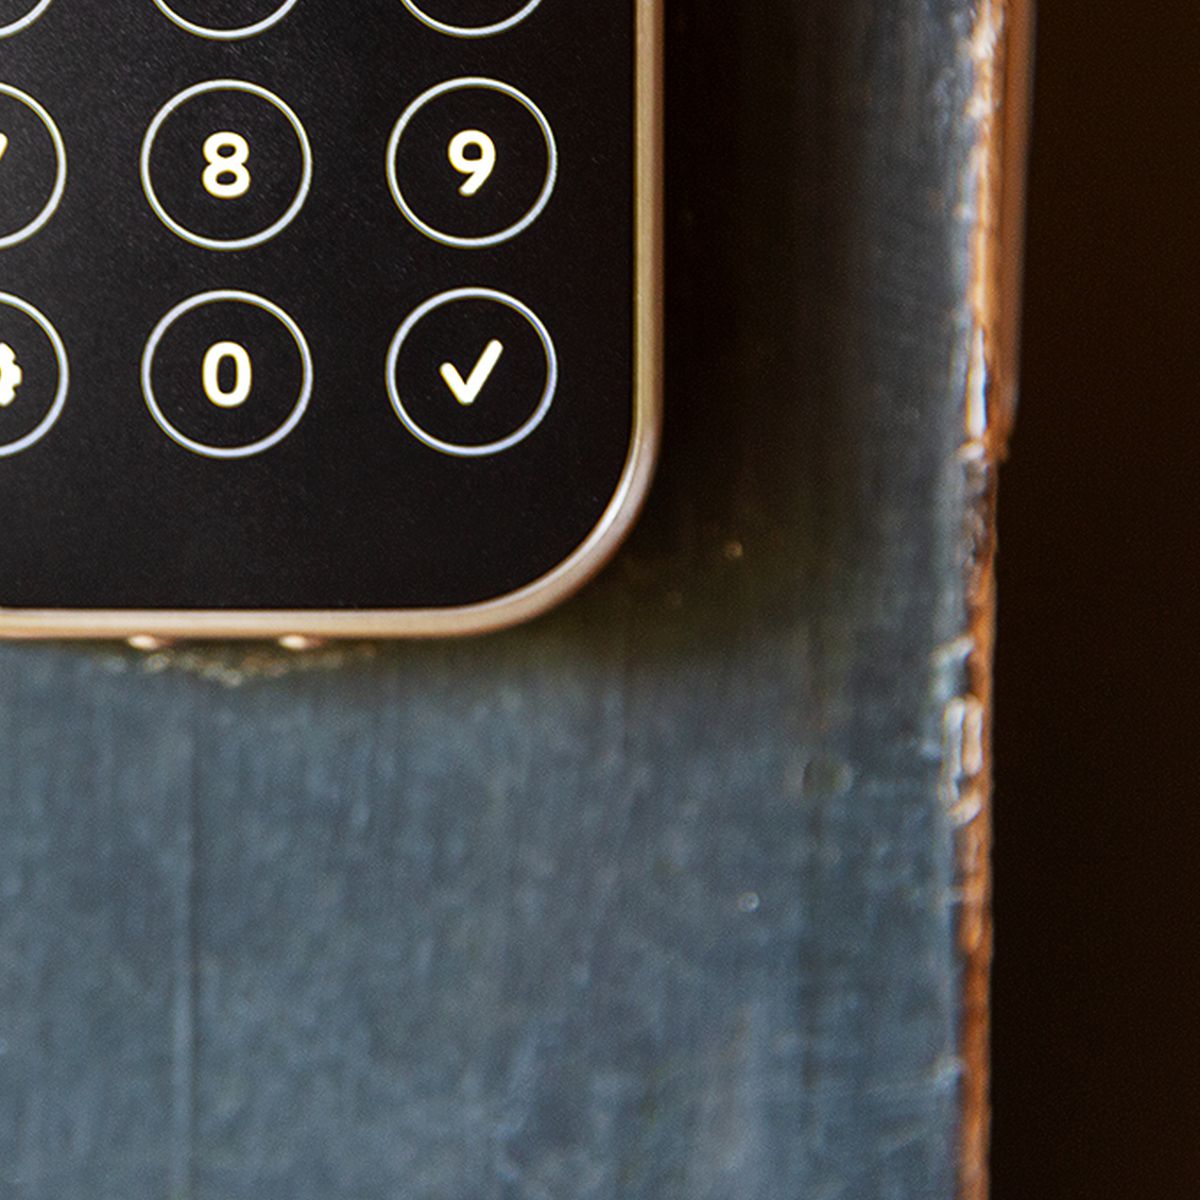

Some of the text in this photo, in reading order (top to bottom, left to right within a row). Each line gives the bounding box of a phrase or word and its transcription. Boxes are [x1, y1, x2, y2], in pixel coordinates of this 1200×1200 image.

[203, 132, 250, 198] 8
[449, 130, 495, 195] 9
[203, 342, 251, 406] 0
